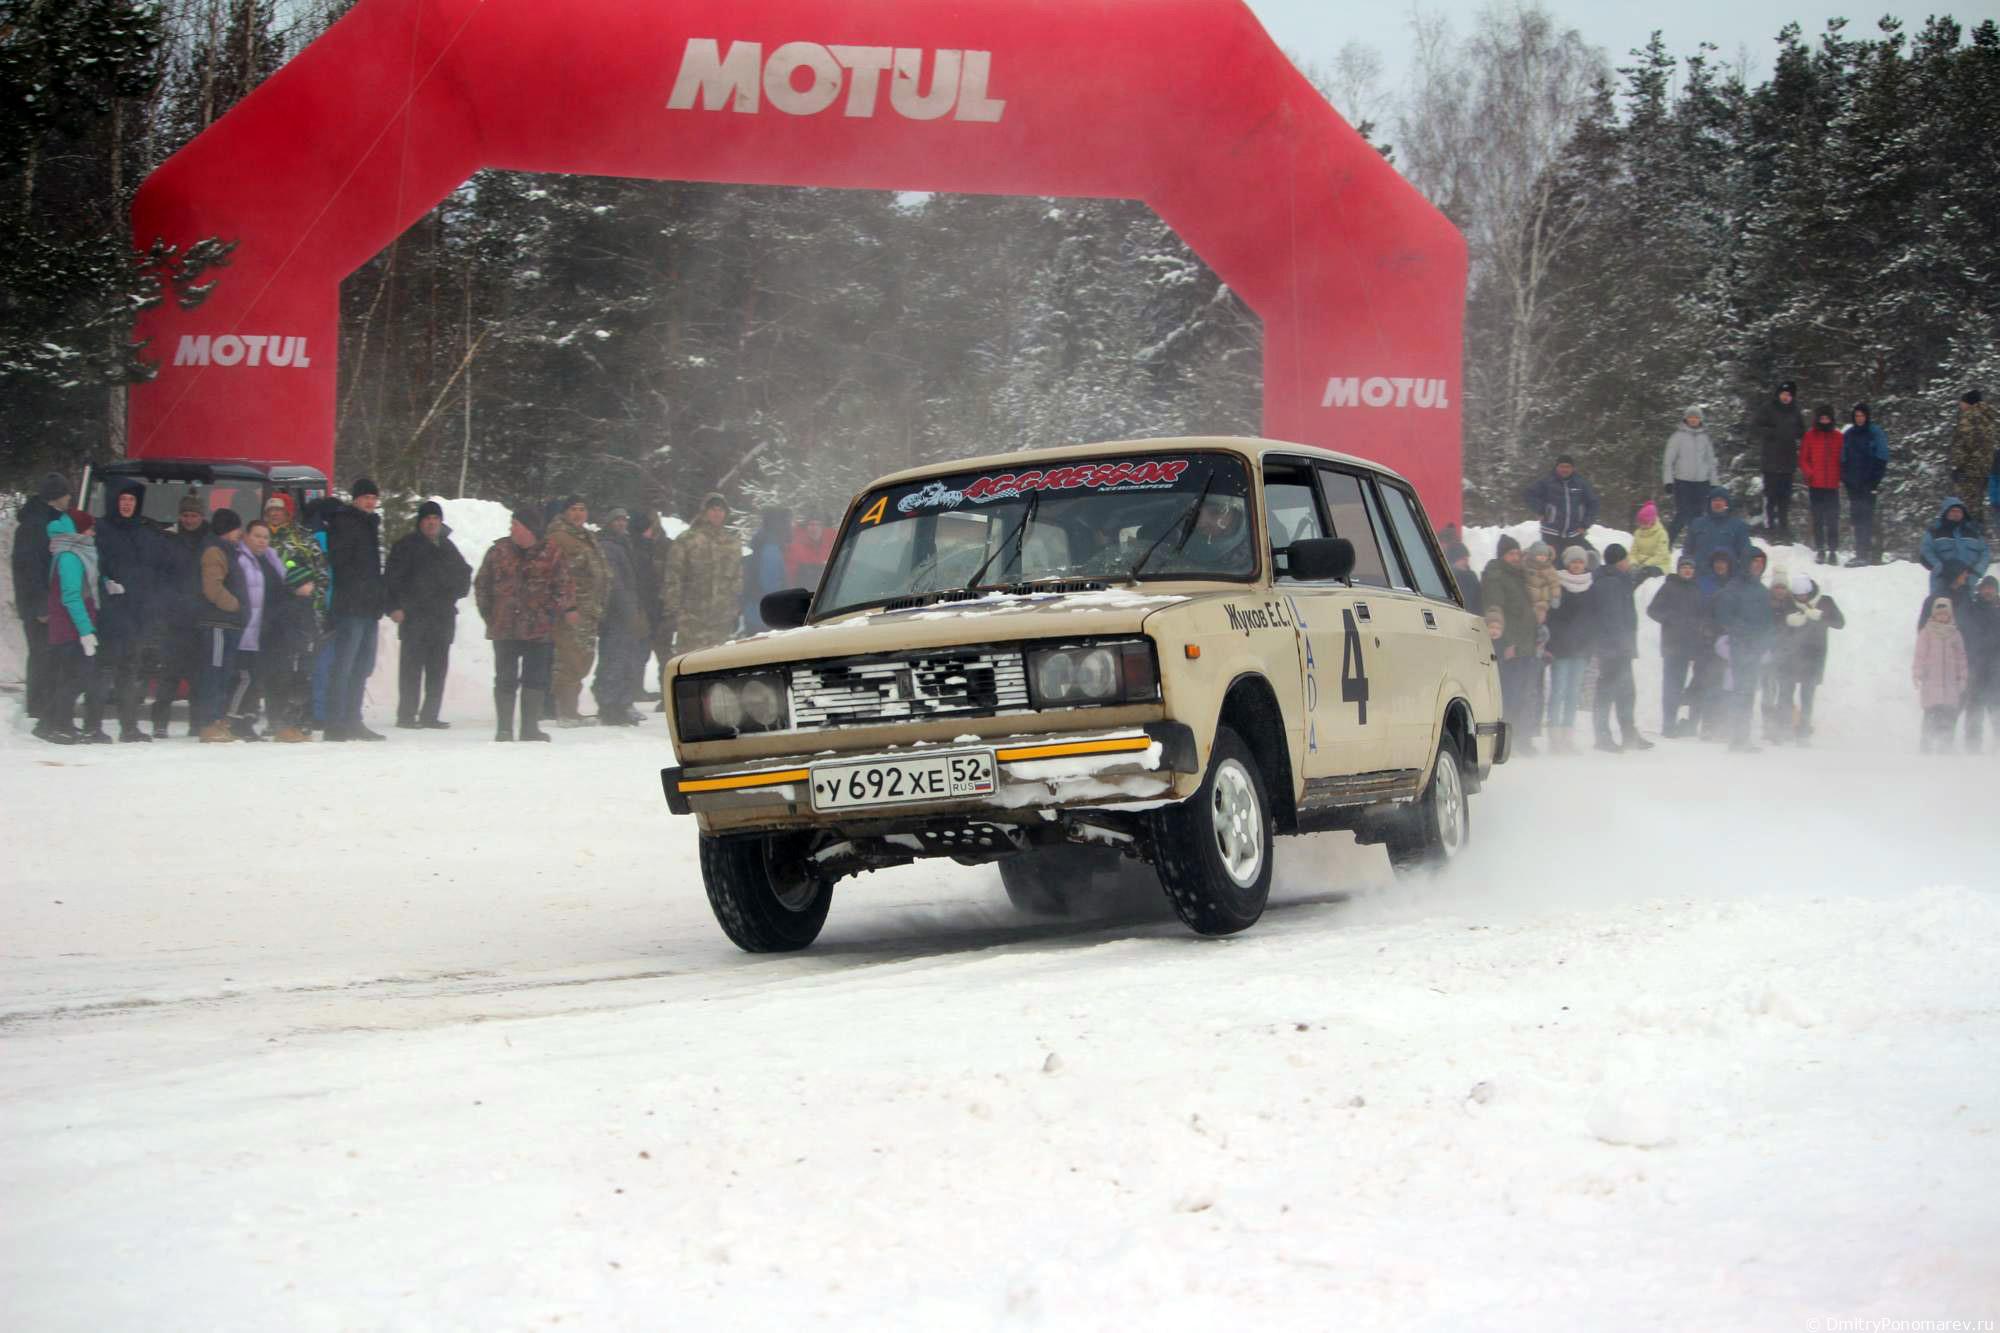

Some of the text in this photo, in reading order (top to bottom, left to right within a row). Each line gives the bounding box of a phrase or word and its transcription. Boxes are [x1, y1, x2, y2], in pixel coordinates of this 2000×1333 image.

[666, 37, 1006, 123] MOTUL
[173, 334, 311, 368] MOTUL
[1321, 376, 1449, 409] MOTUL
[964, 460, 1189, 499] AGGRESSOR
[1223, 603, 1269, 637] Жуков
[1341, 608, 1369, 726] 4
[951, 758, 982, 782] 52
[952, 782, 975, 792] RUS
